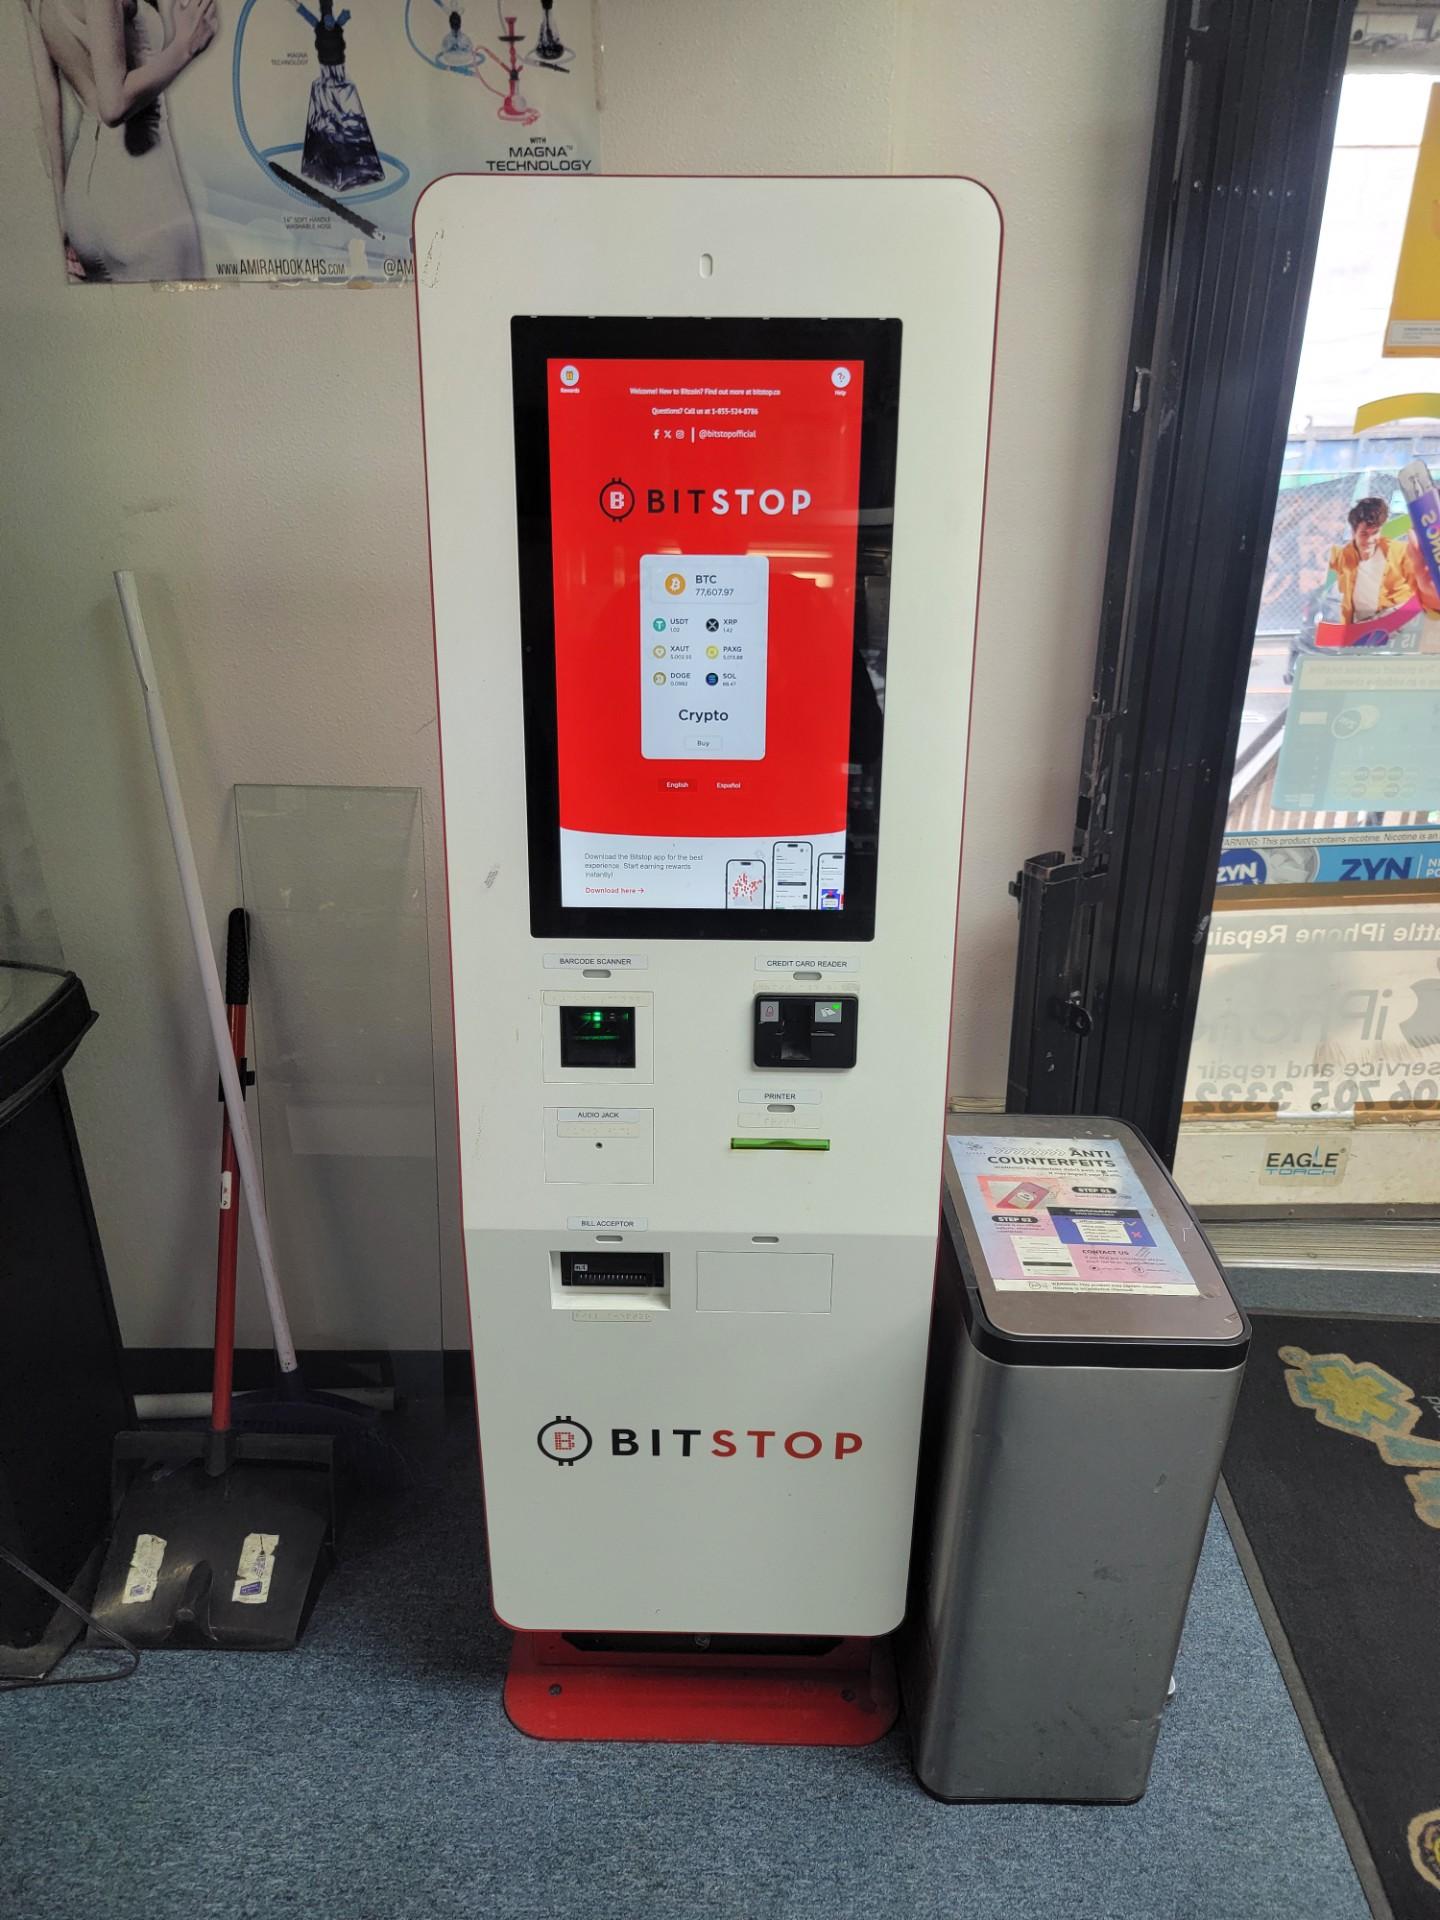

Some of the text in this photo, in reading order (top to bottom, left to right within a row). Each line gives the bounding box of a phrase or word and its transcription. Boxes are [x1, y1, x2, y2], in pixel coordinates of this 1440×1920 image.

[486, 160, 592, 171] TECHNOLOGY
[629, 387, 658, 395] Welcome!
[673, 387, 680, 395] to
[680, 387, 704, 395] Bitcoin?
[752, 388, 781, 397] bitstop.co
[834, 389, 847, 397] Help
[652, 407, 684, 416] Questions?
[684, 407, 696, 415] Call
[699, 429, 756, 440] @bitstopofficial
[647, 488, 812, 516] BITSTOP
[695, 574, 717, 584] BTC
[695, 588, 734, 597] 77,607.97
[678, 709, 729, 724] Crypto
[666, 781, 689, 789] English
[716, 781, 741, 789] Español
[1262, 836, 1279, 845] This
[1280, 836, 1311, 845] product
[1312, 835, 1346, 843] contains
[1384, 833, 1417, 841] Nicotine
[630, 853, 651, 861] Bitstop
[667, 853, 676, 861] for
[639, 863, 664, 871] earning
[1216, 861, 1258, 882] ZYN
[1339, 856, 1413, 880] ZYN
[1070, 1150, 1111, 1159] ANTI
[1266, 1149, 1340, 1168] EAGLE
[987, 1156, 1117, 1168] COUNTERFEITS
[1264, 1168, 1337, 1176] TORCH
[596, 1220, 634, 1228] ACCEPTOR
[611, 1428, 863, 1460] BITSTOP
